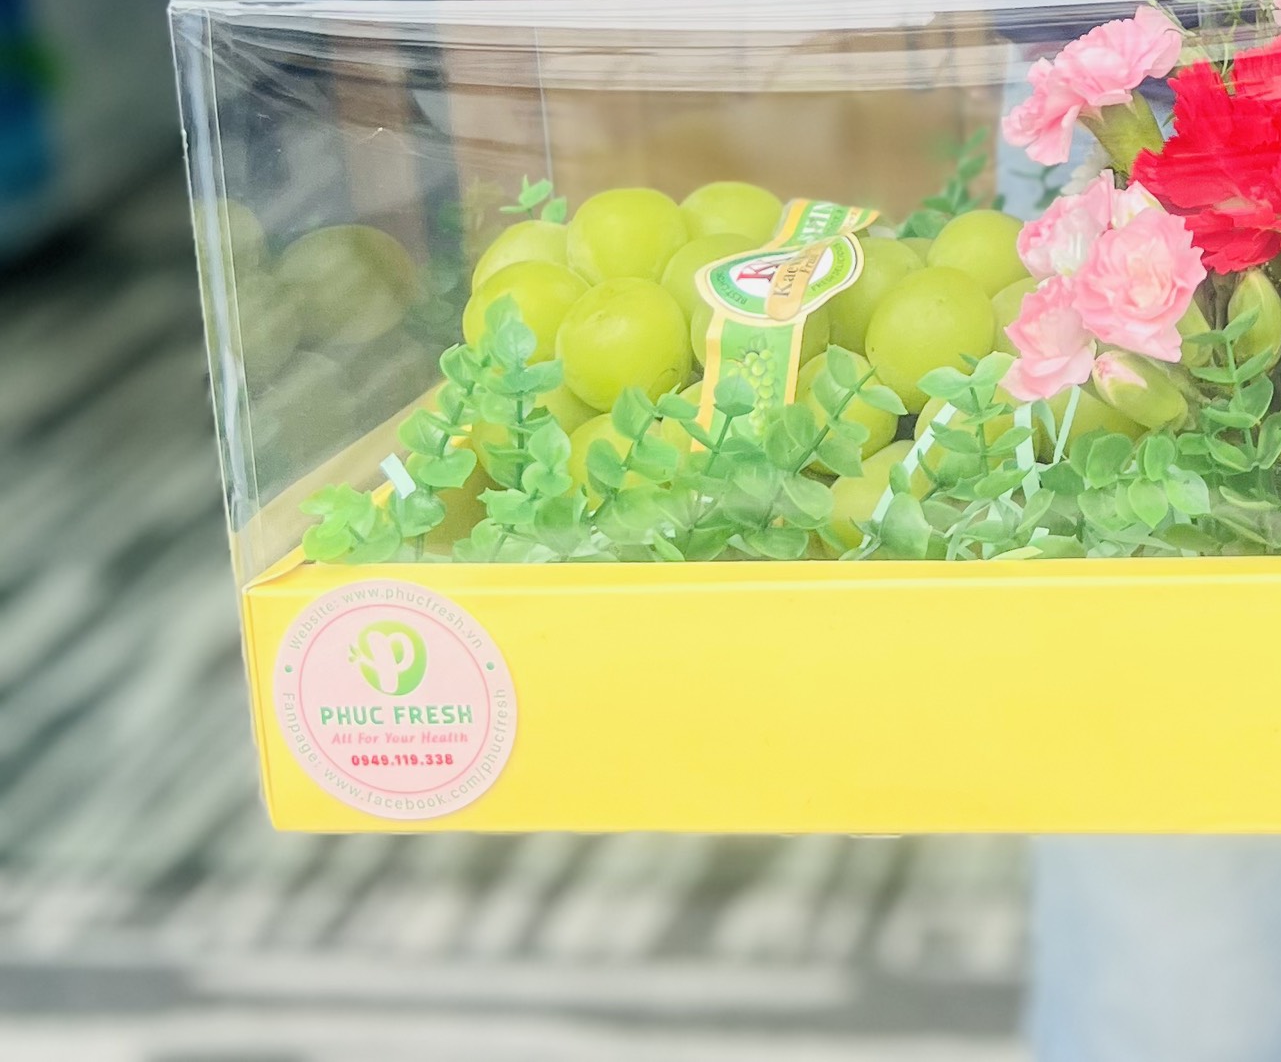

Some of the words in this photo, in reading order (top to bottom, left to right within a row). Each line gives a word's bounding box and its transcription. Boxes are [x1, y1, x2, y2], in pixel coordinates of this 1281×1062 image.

[342, 588, 483, 650] www.phucfresh.vn
[320, 706, 384, 725] PHUC
[393, 705, 473, 725] FRESH
[325, 689, 508, 810] www.facebook.com/phucfresh
[358, 732, 379, 744] For
[385, 732, 415, 744] Your
[422, 731, 468, 744] Health
